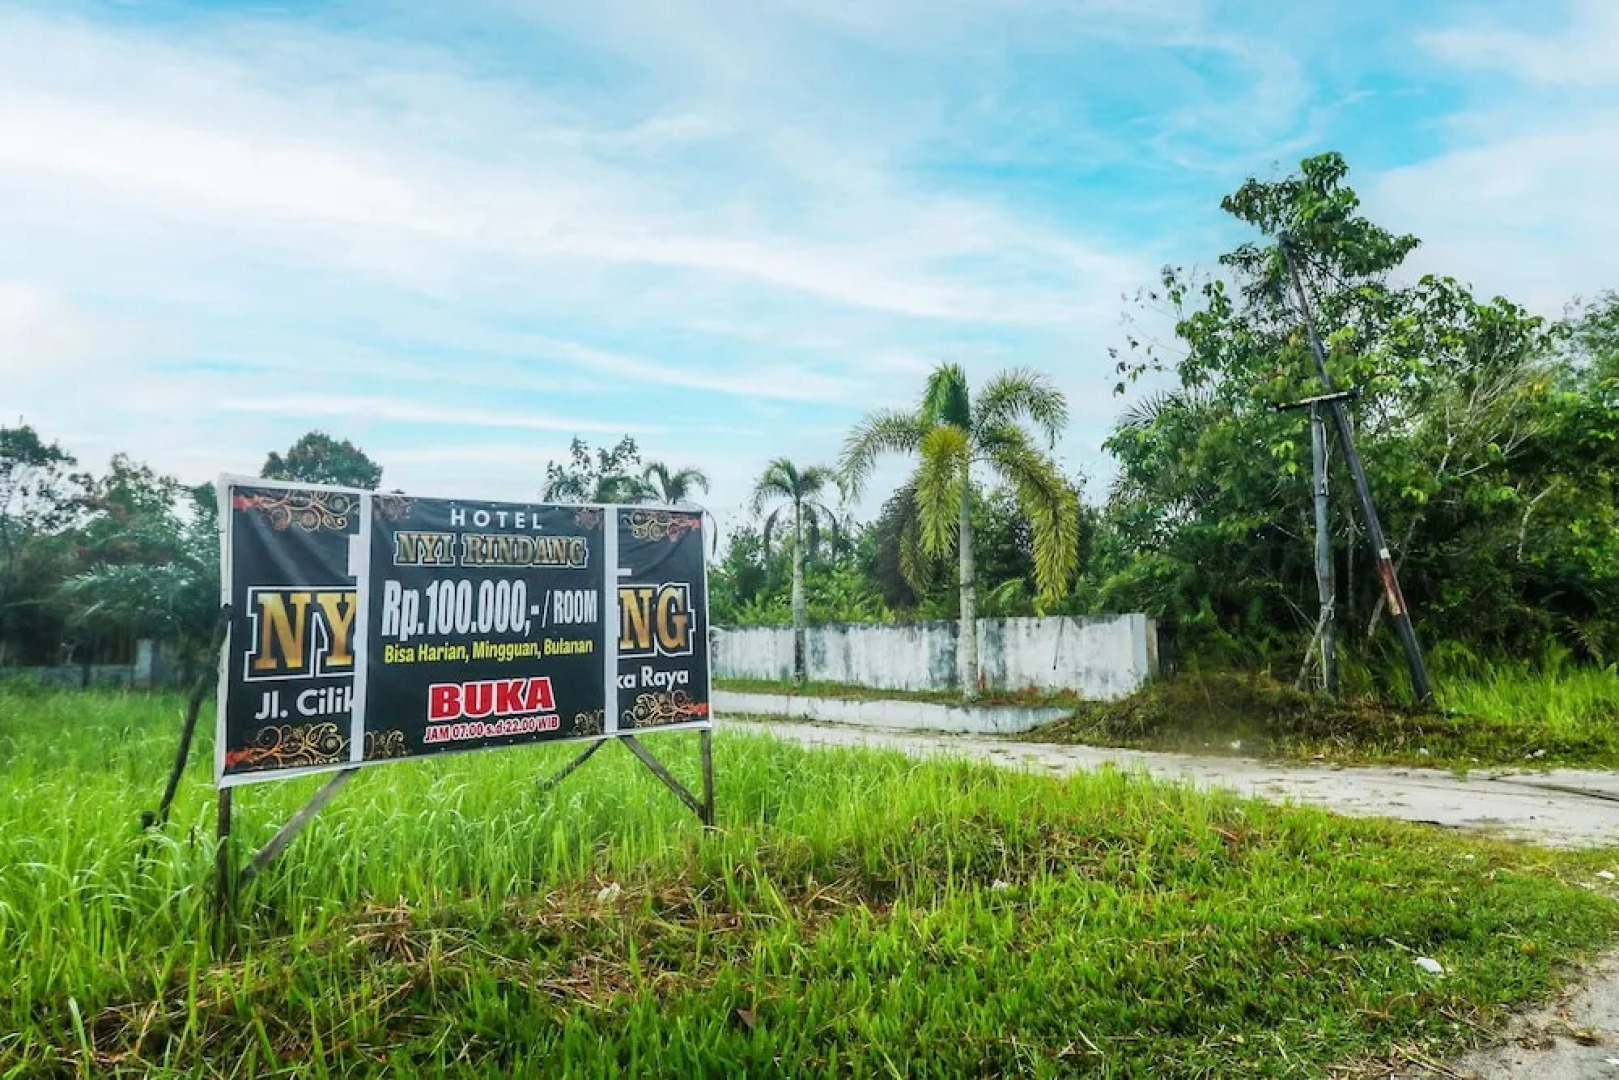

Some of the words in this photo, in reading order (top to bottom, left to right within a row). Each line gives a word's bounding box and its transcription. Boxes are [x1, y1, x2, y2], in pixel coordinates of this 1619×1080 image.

[451, 508, 542, 529] HOTEL
[394, 531, 456, 566] NYI
[461, 533, 589, 568] RINDANG
[553, 589, 598, 624] ROOM
[384, 644, 415, 663] Bisa
[418, 642, 469, 664] Harian,
[472, 640, 541, 661] Mingguan,
[543, 637, 593, 655] Bulanan
[641, 665, 689, 691] Raya
[255, 690, 288, 719] Jl.
[429, 676, 555, 721] BUKA
[424, 725, 450, 743] JAM
[538, 714, 560, 732] WIB
